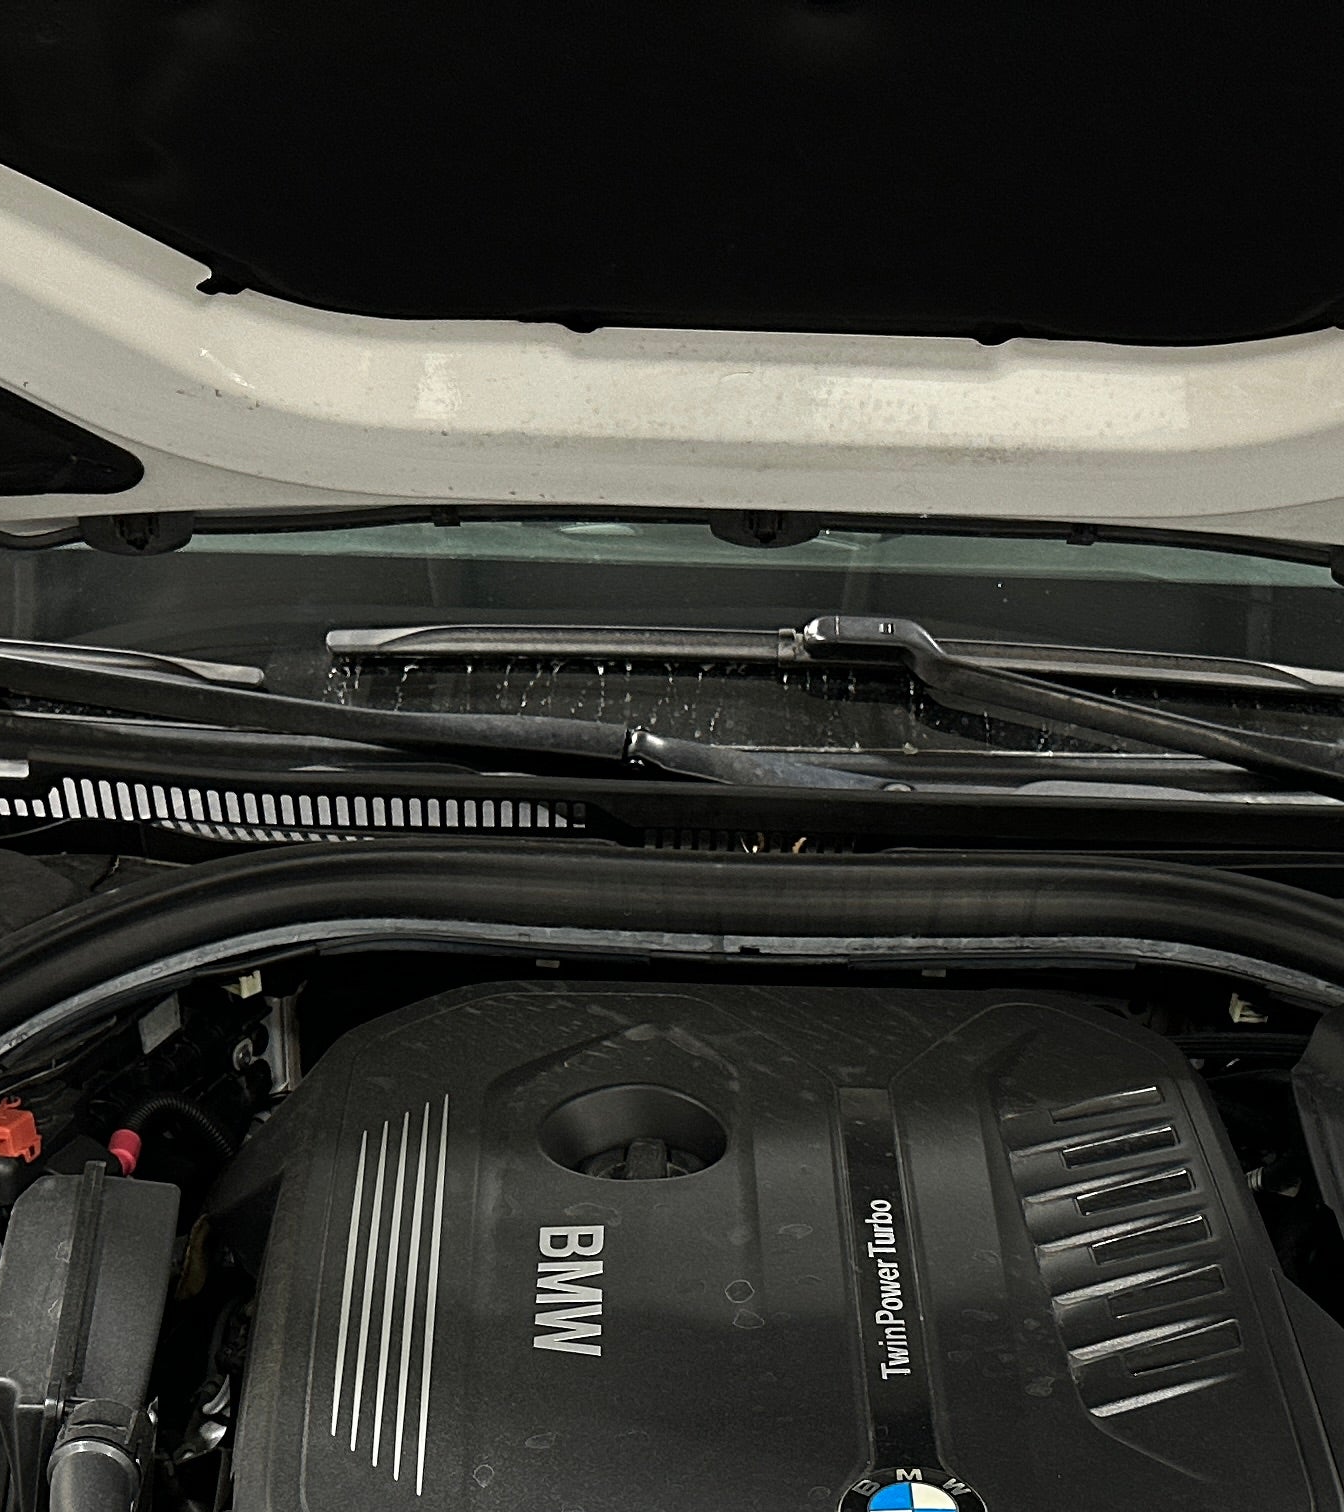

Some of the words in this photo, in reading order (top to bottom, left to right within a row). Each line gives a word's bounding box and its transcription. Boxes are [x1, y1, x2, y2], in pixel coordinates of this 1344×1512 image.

[864, 1199, 897, 1258] Turbo
[533, 1225, 605, 1357] BMW
[874, 1258, 911, 1380] TwinPower
[851, 1467, 973, 1498] BMW
